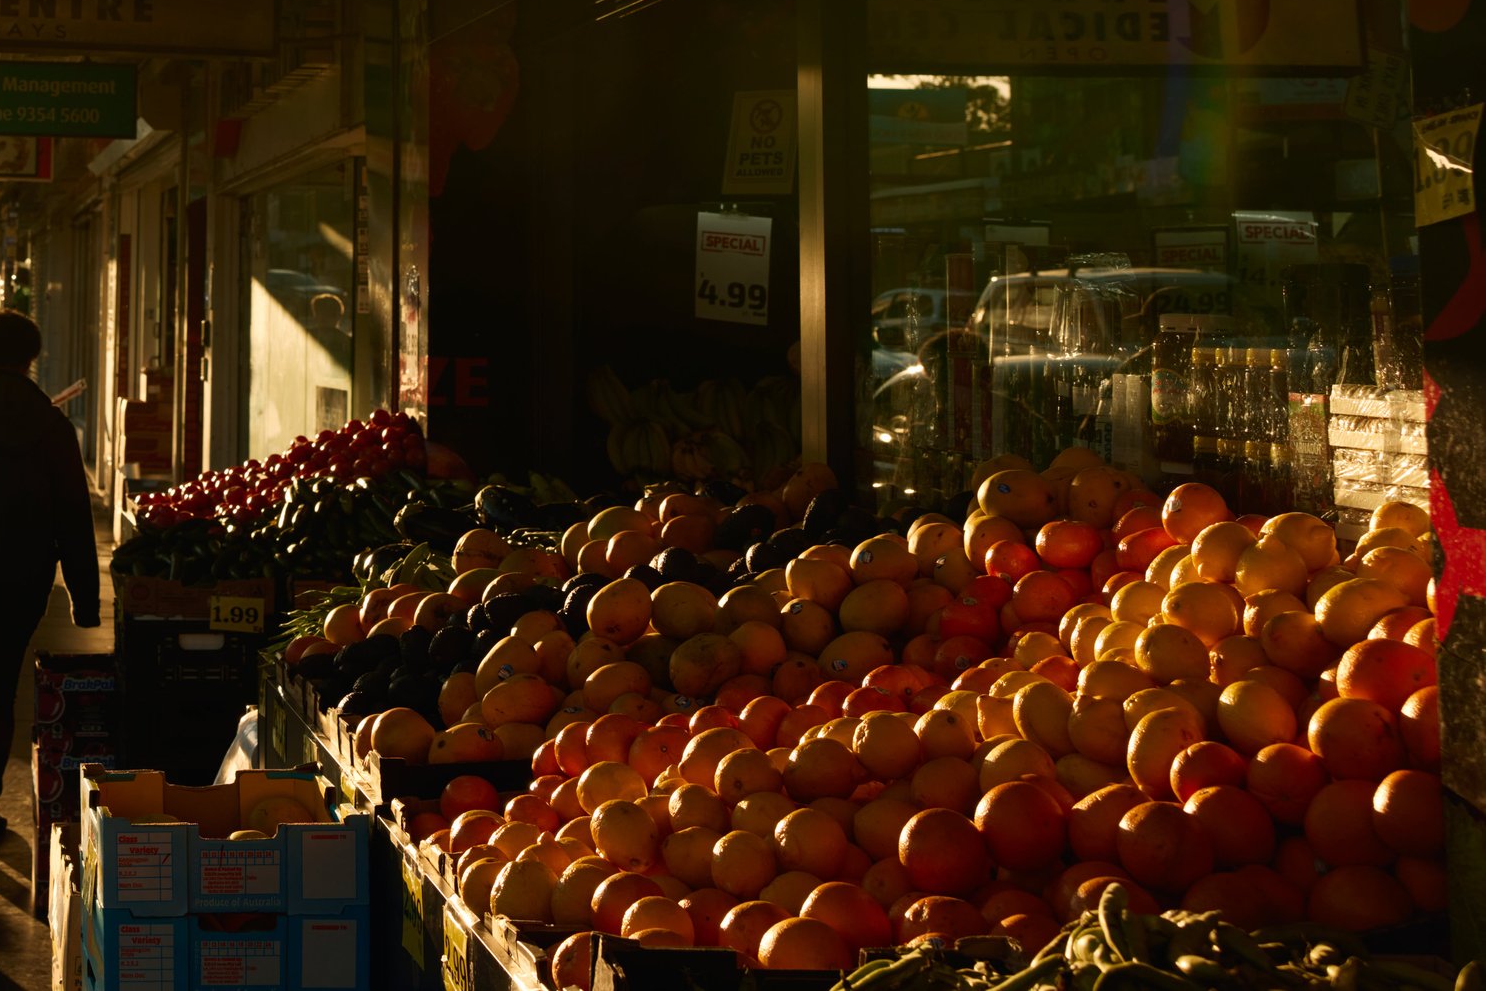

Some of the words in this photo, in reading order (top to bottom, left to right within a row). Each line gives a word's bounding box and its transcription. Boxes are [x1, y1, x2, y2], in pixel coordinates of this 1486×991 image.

[2, 76, 117, 97] Management
[17, 106, 56, 123] 9354
[61, 107, 101, 124] 5600
[751, 136, 776, 149] NO
[739, 151, 784, 166] PETS
[736, 167, 784, 178] ALLOWED
[1245, 225, 1309, 240] SPECIAL
[706, 235, 760, 251] SPECIAL
[1161, 248, 1220, 262] SPECIAL
[698, 280, 766, 309] 4.99
[212, 605, 259, 625] 1.99
[118, 835, 138, 844] Class
[129, 845, 159, 856] Variety
[194, 897, 228, 907] Produce
[231, 897, 240, 907] of
[242, 896, 281, 907] Australia
[120, 925, 140, 934] Class
[131, 936, 162, 946] Variety
